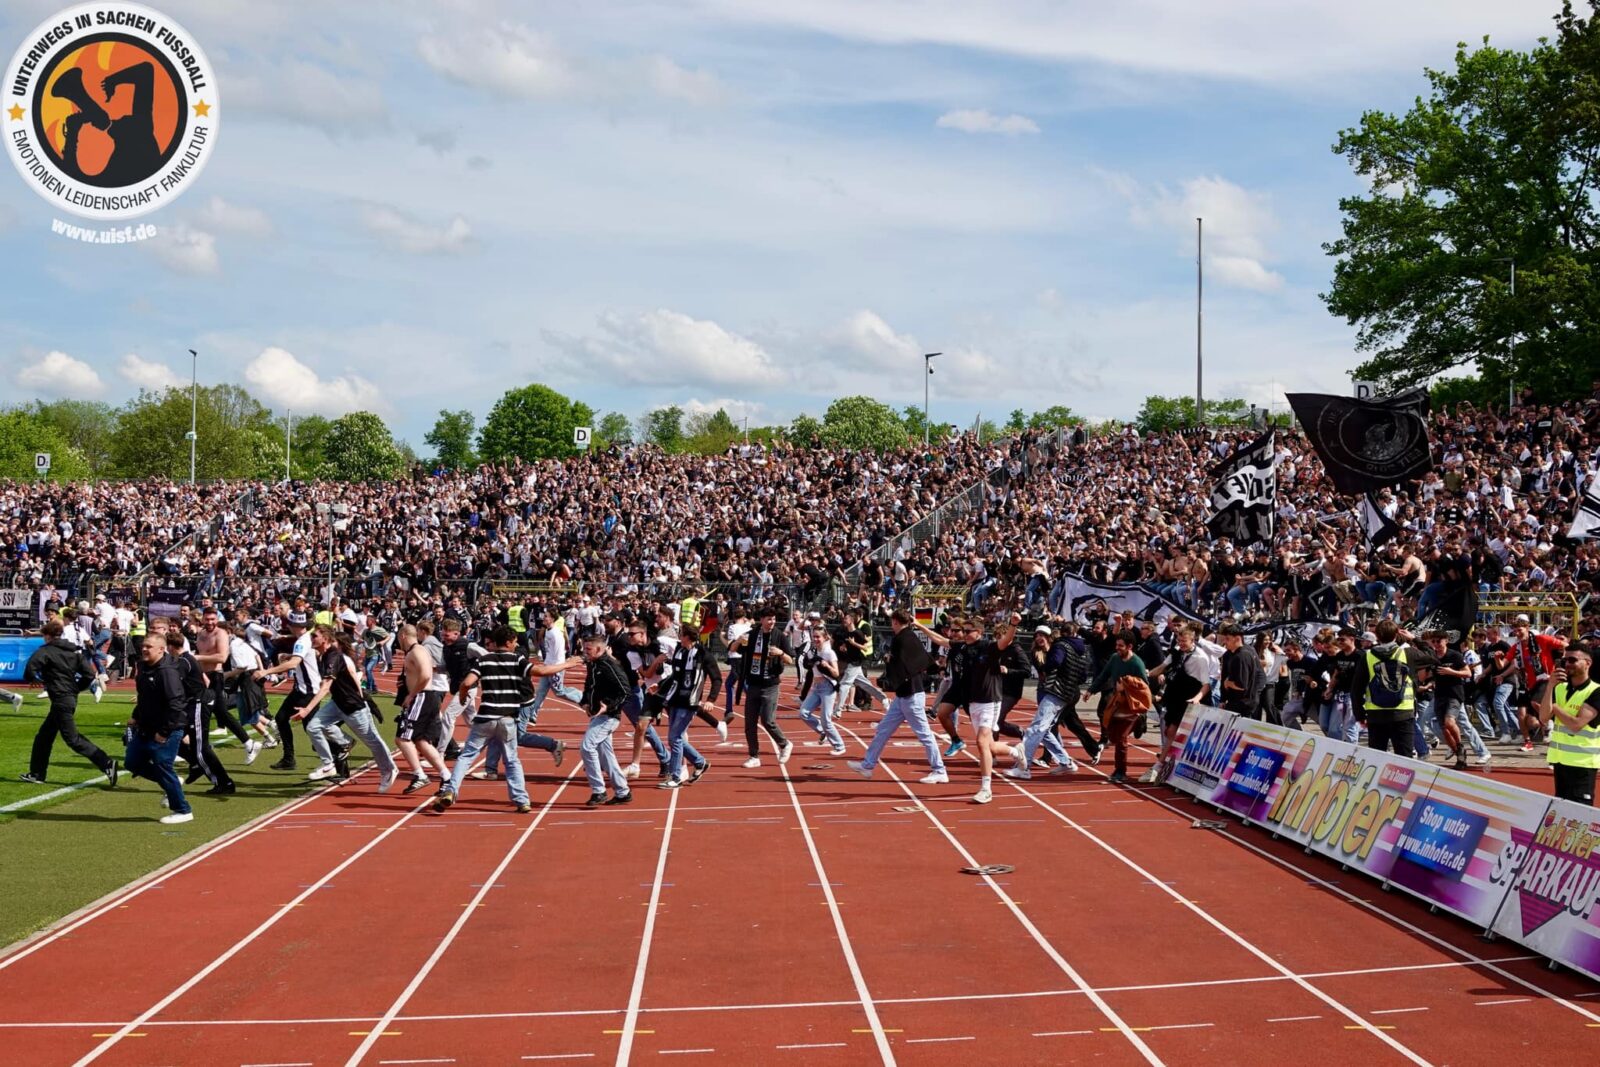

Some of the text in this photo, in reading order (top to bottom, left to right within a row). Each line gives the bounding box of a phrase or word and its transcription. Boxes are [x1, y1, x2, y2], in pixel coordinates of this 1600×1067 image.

[3, 592, 16, 606] SSV
[1267, 738, 1403, 860] inhofer
[1420, 805, 1470, 838] Shop unter
[1397, 833, 1466, 872] www.inhofer.de
